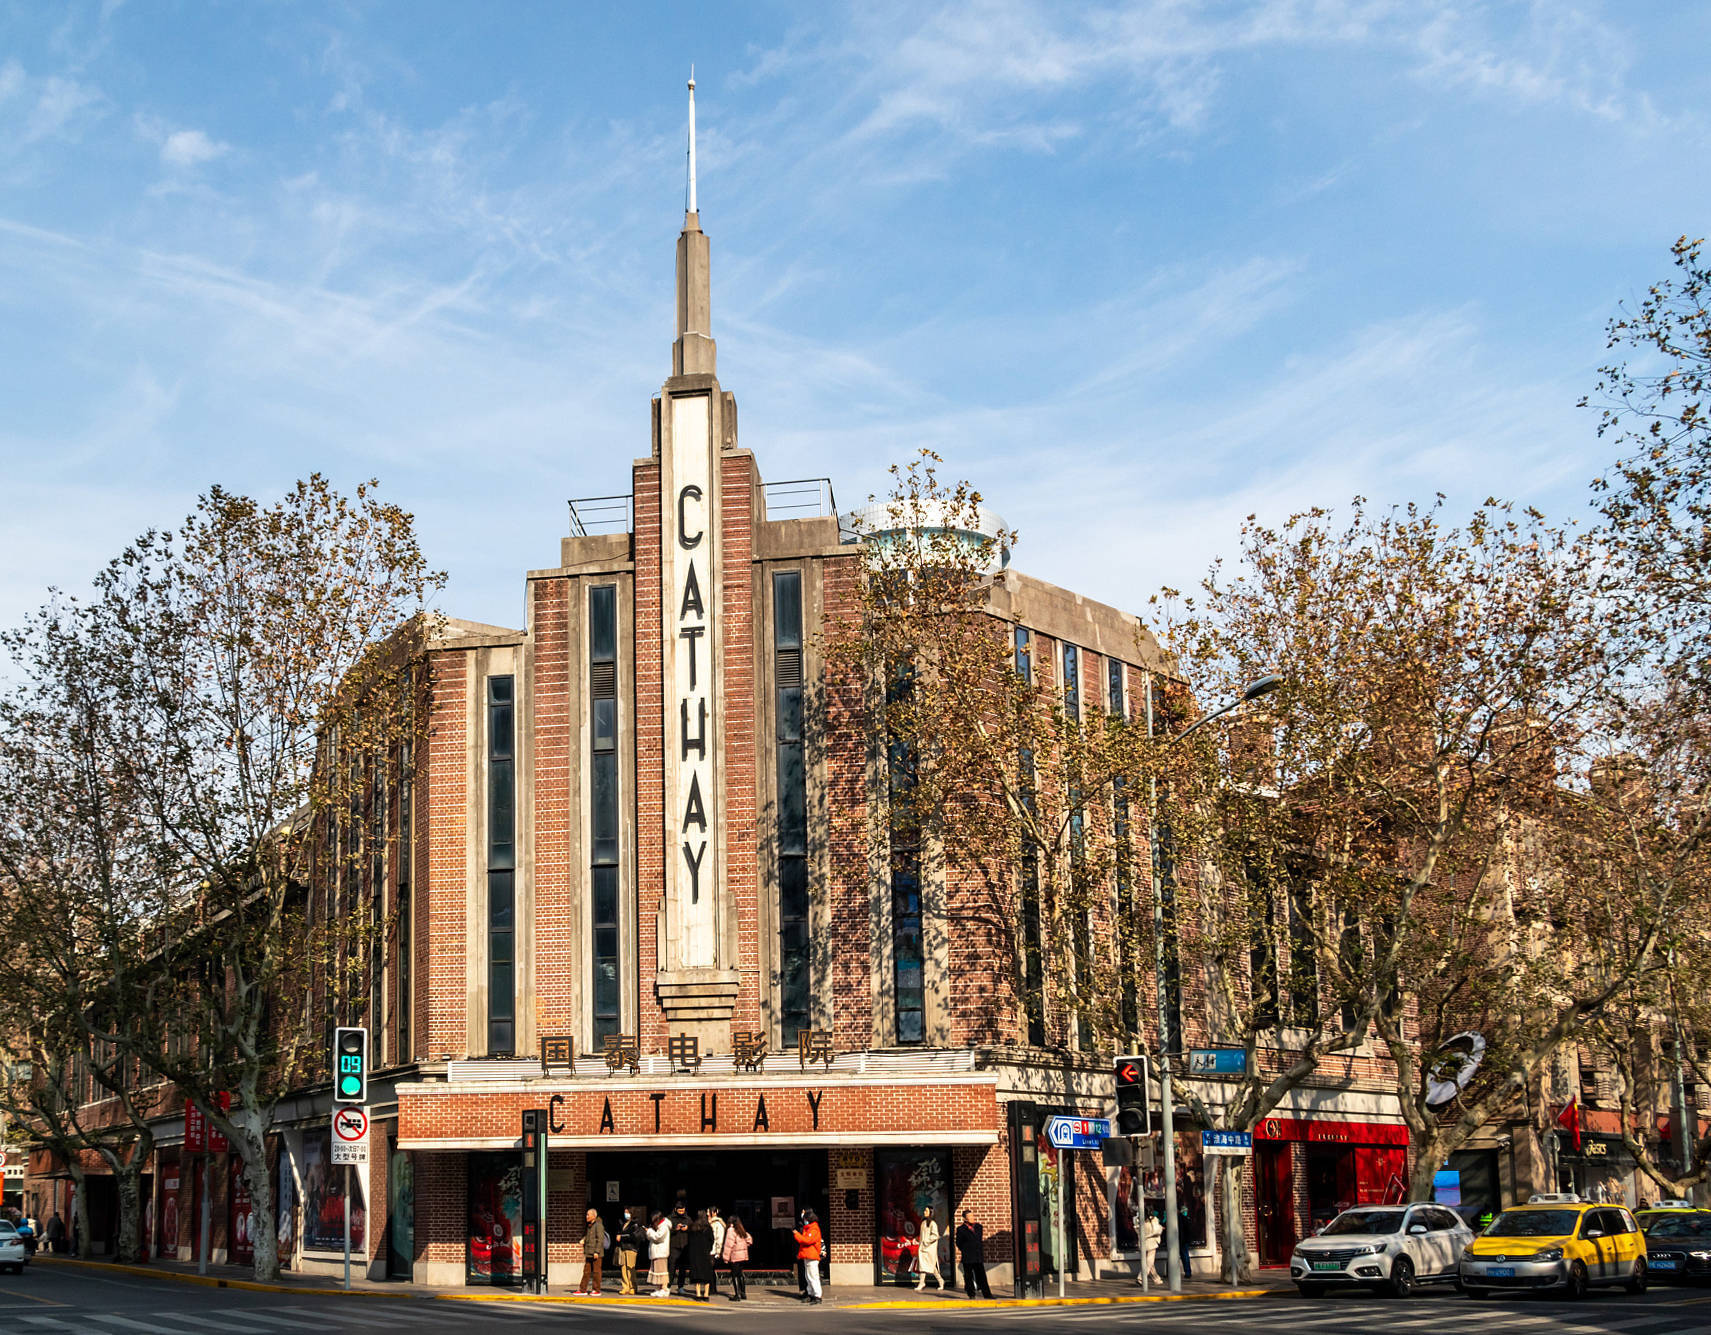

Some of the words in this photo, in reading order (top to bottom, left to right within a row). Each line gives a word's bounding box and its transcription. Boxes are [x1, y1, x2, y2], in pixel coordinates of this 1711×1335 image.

[677, 484, 707, 905] CATHAY
[341, 1055, 361, 1073] 09
[540, 1028, 836, 1070] 国泰电影院
[549, 1090, 823, 1134] CATHAY
[334, 1153, 366, 1163] 大型号牌
